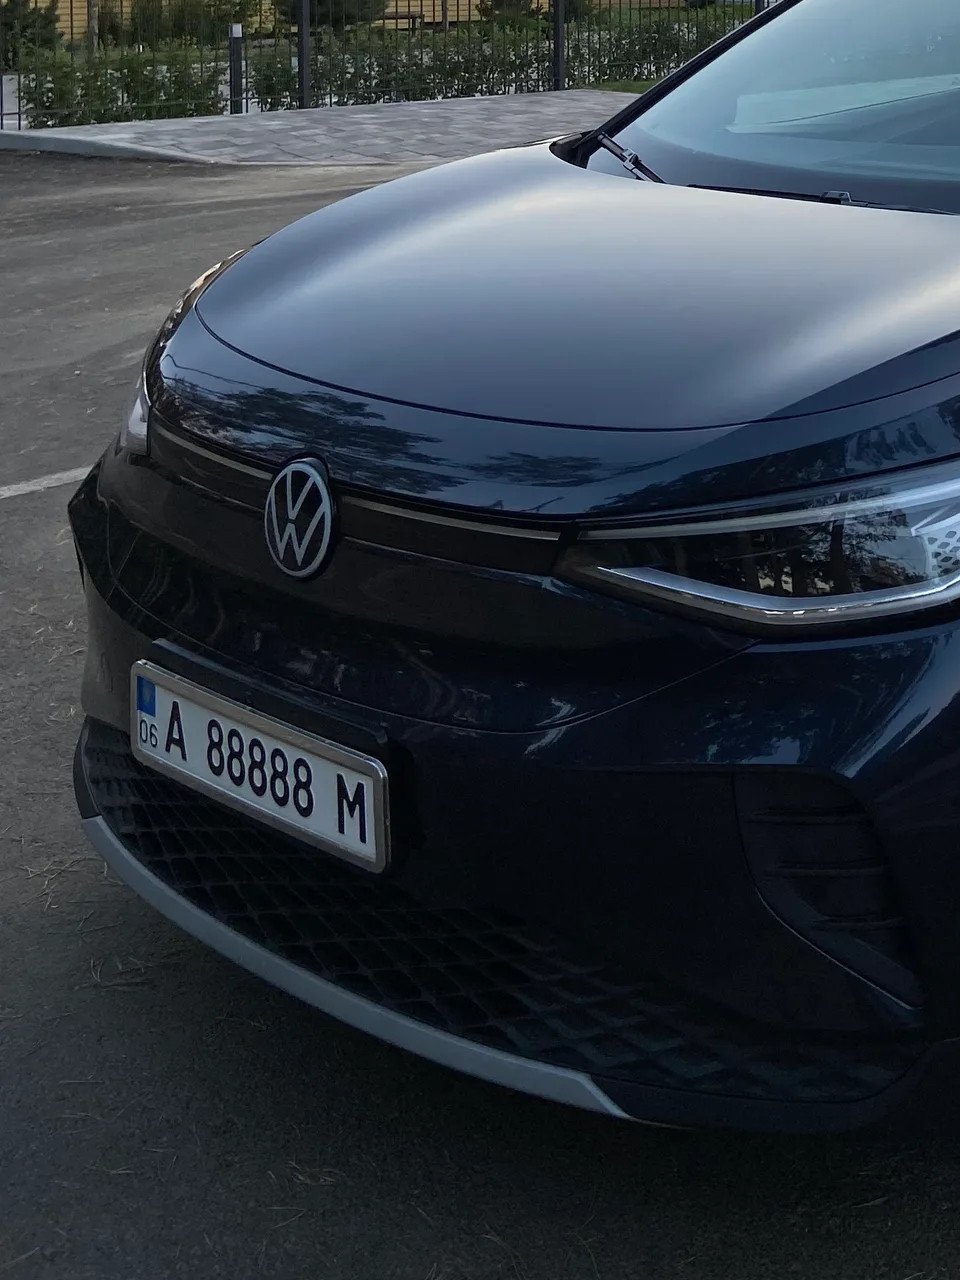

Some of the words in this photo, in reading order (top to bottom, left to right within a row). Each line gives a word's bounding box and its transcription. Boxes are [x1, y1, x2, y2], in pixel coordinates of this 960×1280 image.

[139, 718, 158, 748] 06
[165, 701, 187, 762] A
[206, 718, 314, 818] 88888
[336, 772, 367, 844] M
